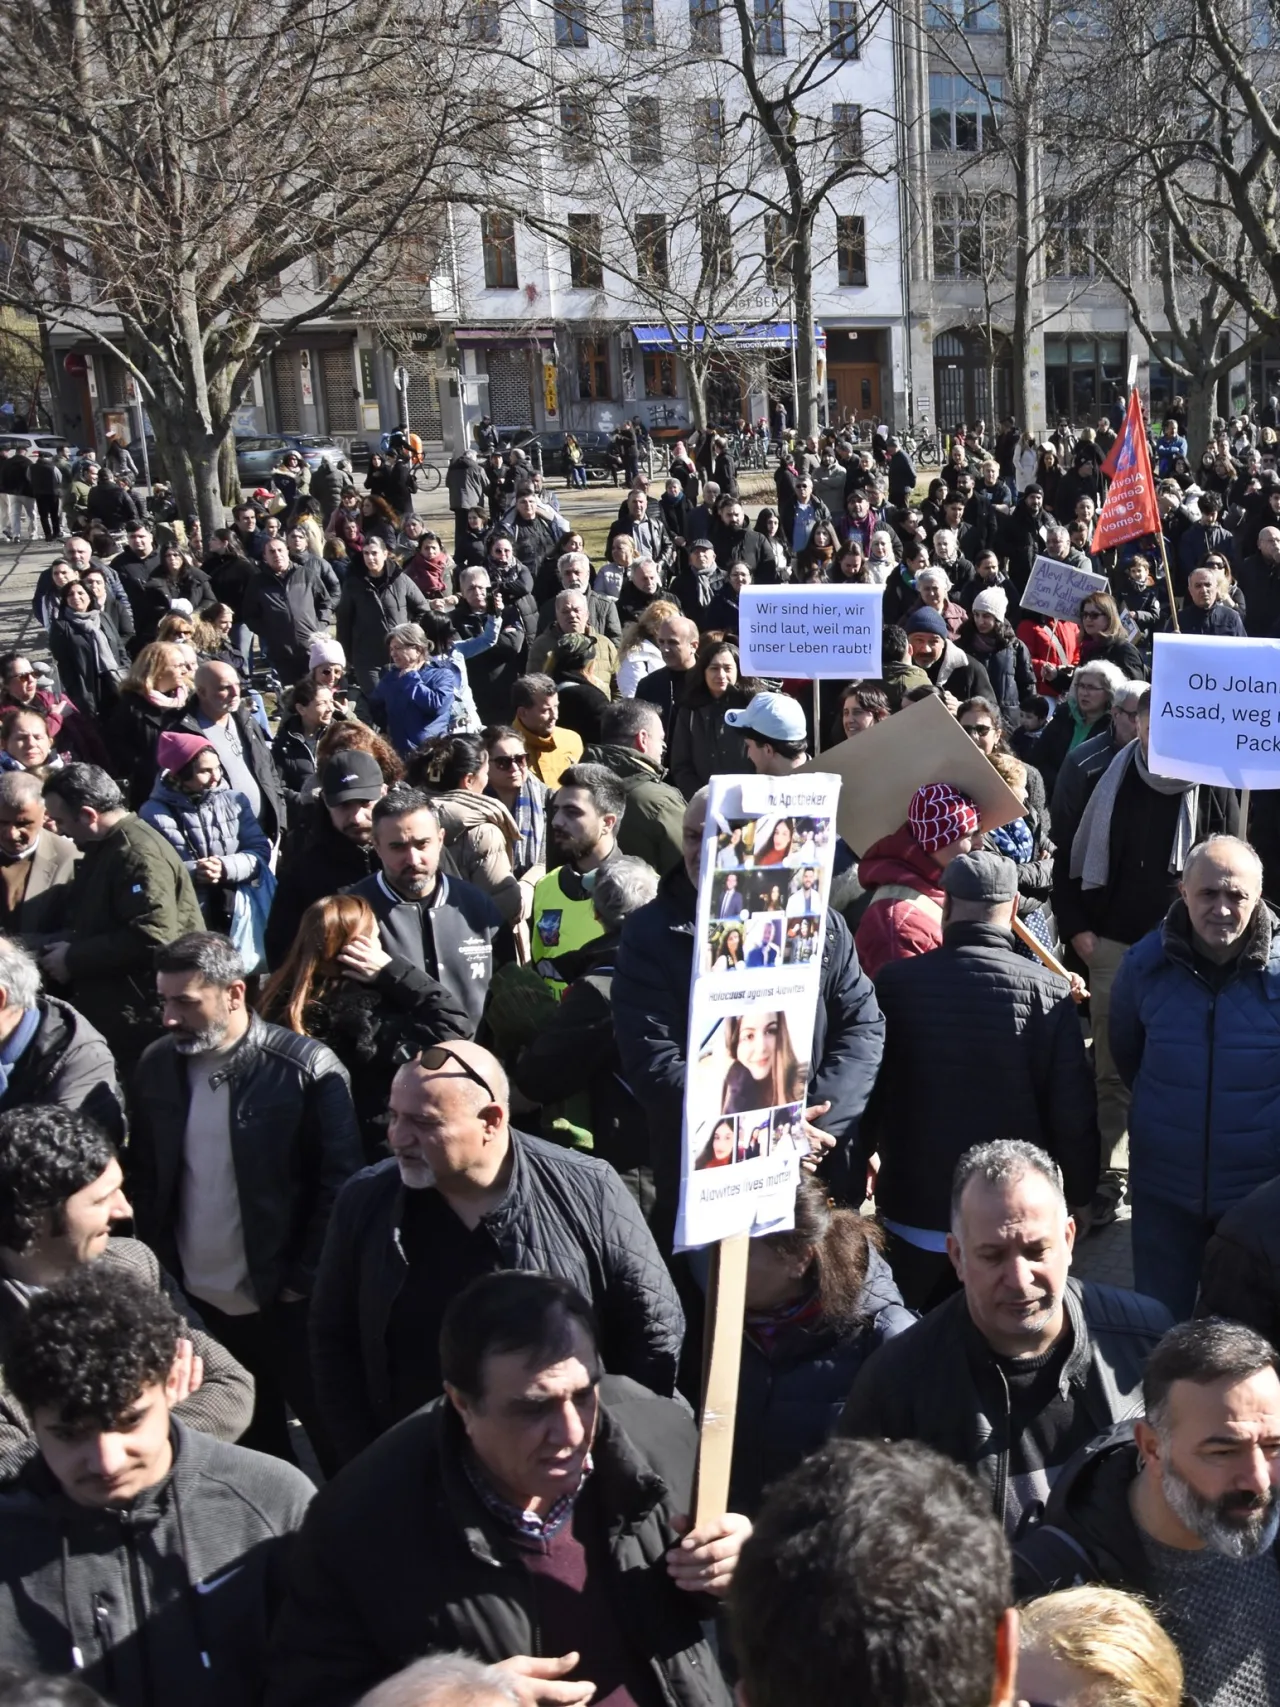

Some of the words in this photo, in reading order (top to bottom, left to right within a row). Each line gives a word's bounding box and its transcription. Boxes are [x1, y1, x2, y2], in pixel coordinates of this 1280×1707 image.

[1036, 562, 1062, 580] Alevi
[756, 603, 778, 615] Wir
[781, 603, 808, 615] sind
[812, 604, 841, 618] hier,
[844, 605, 865, 615] wir
[750, 622, 777, 634] sind
[781, 622, 810, 636] laut,
[813, 623, 839, 635] weil
[842, 625, 871, 635] man
[749, 643, 786, 653] unser
[789, 642, 829, 653] Leben
[832, 643, 872, 655] raubt!
[1188, 673, 1217, 691] Ob
[1160, 701, 1225, 724] Assad,
[1232, 708, 1271, 727] weg
[709, 990, 746, 1001] Holocaust
[747, 987, 774, 1000] against
